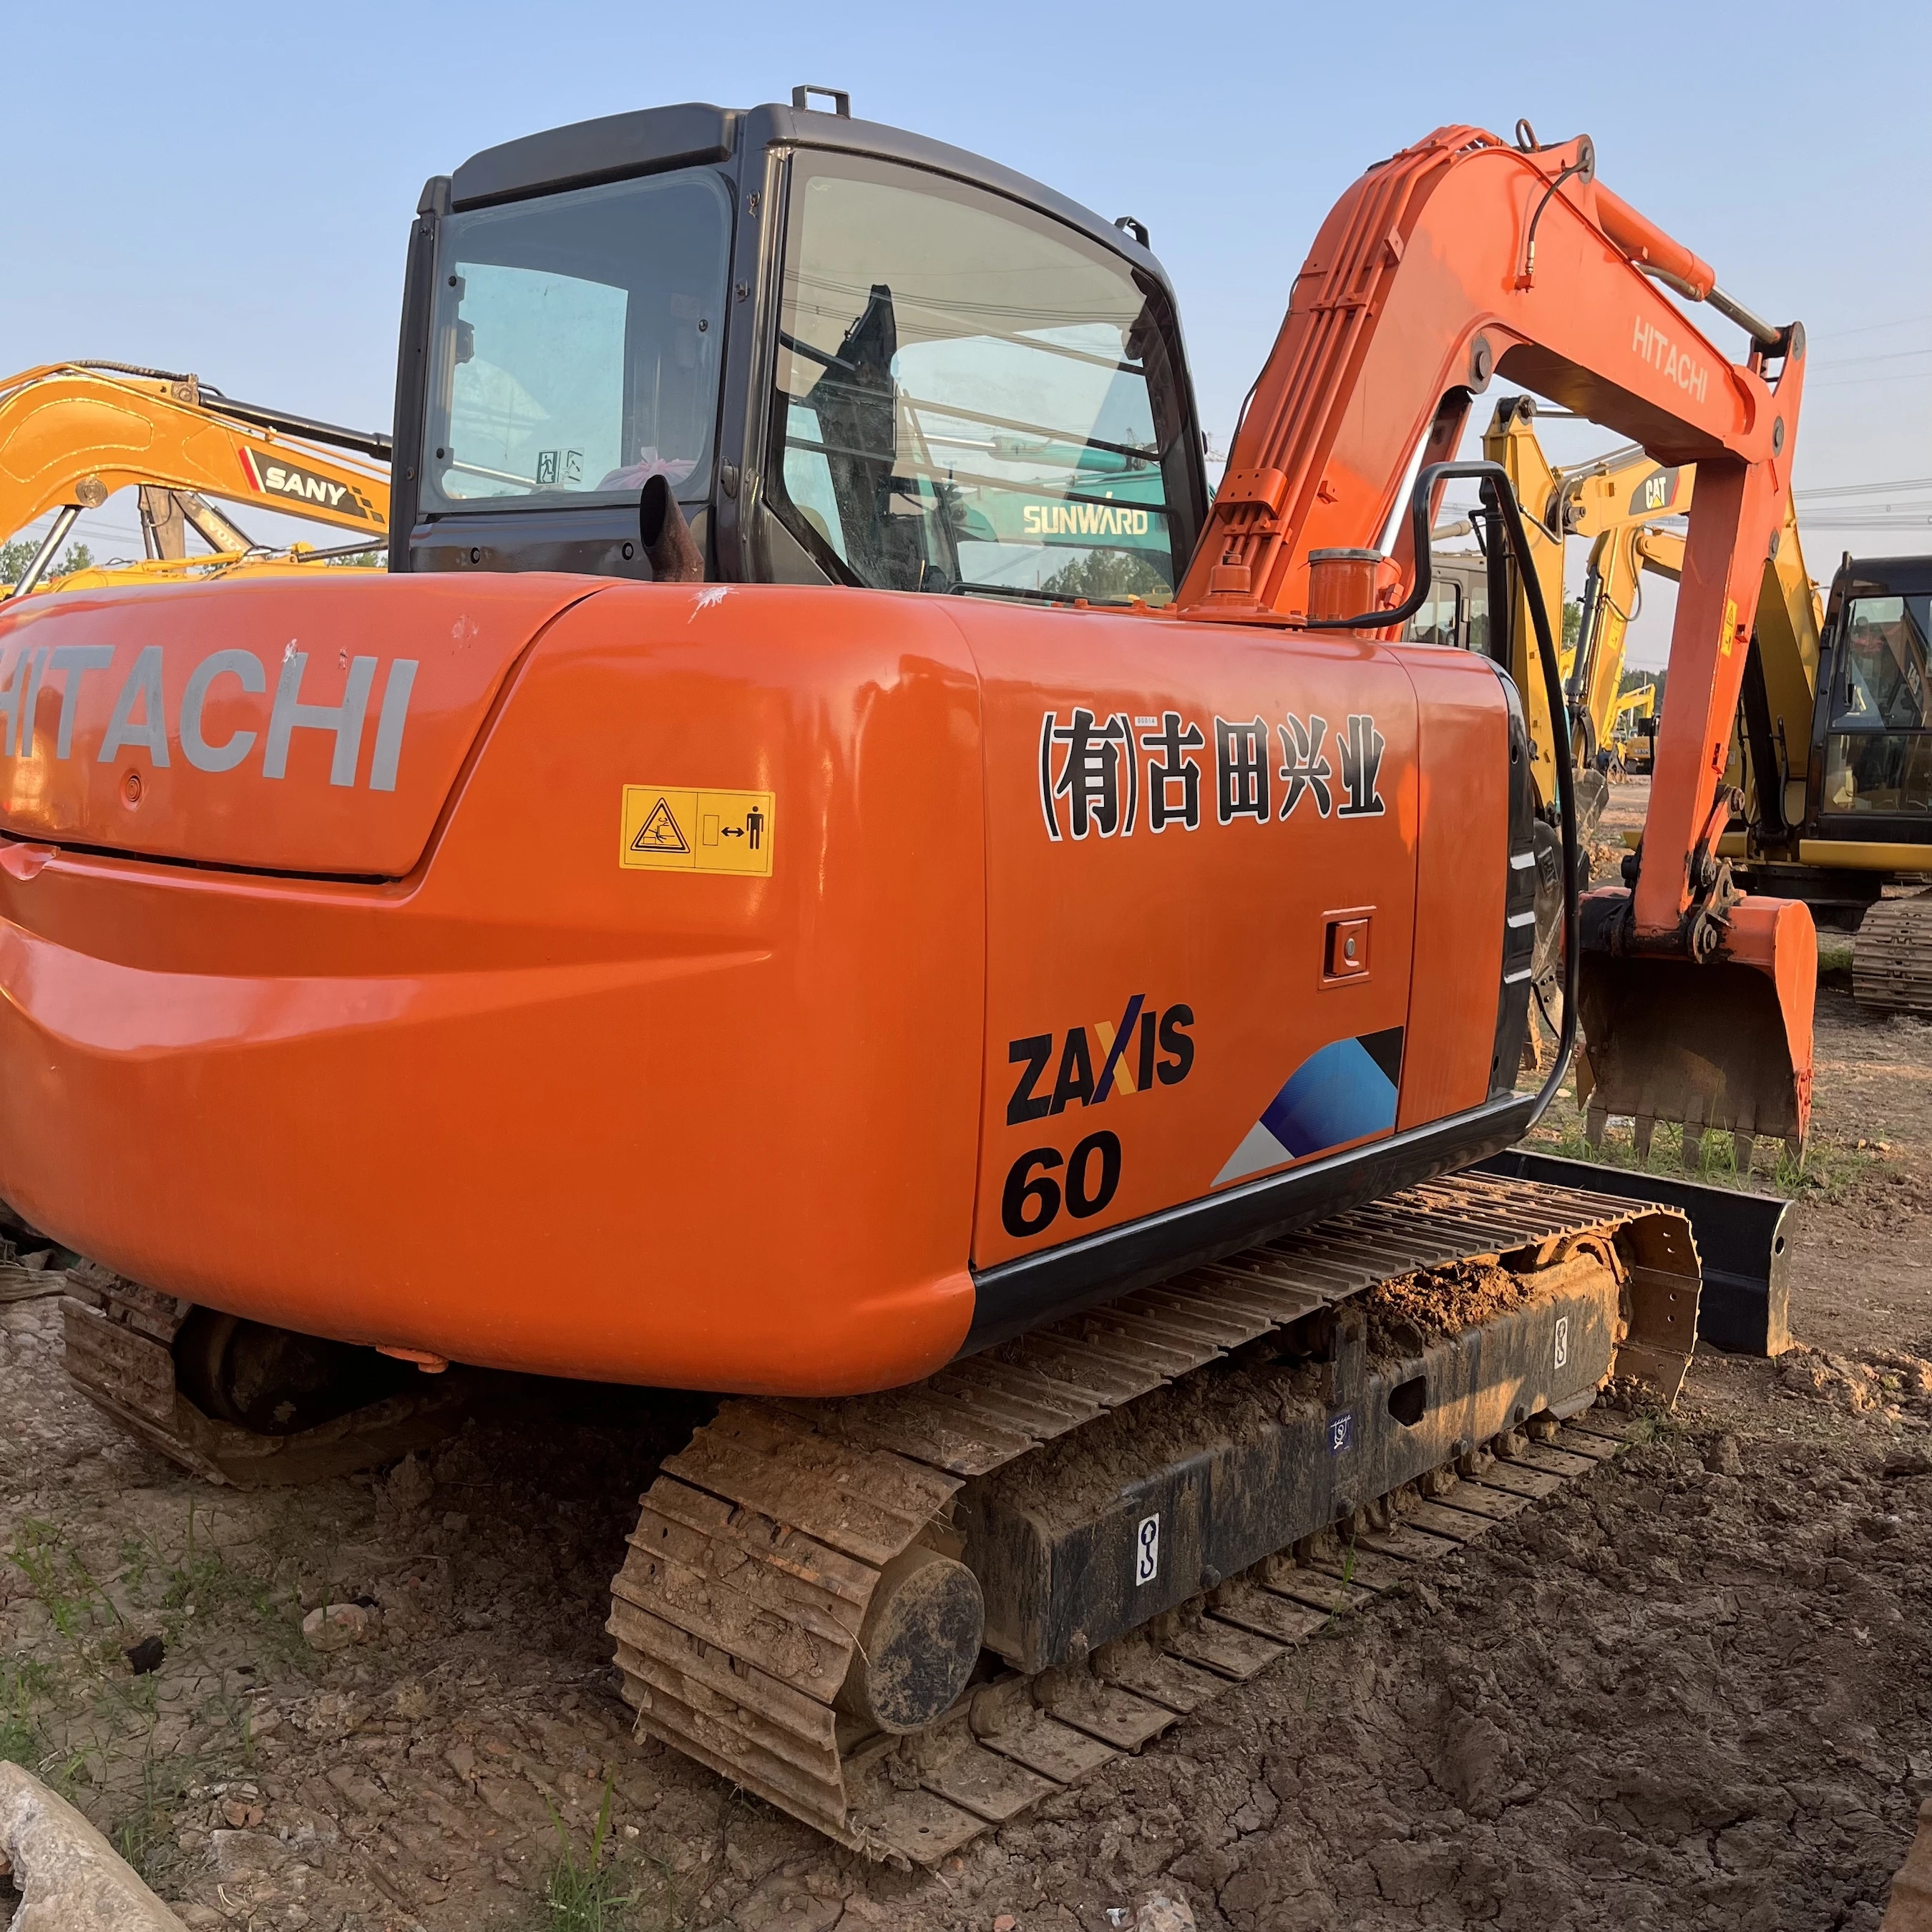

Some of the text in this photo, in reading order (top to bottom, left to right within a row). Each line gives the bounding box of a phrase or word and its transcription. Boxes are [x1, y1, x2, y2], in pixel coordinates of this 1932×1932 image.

[1632, 315, 1708, 404] HITACHI
[265, 467, 347, 506] SANY
[1023, 491, 1148, 535] SUNWARD
[1645, 477, 1666, 509] CAT
[0, 645, 419, 791] HITACHI
[1007, 994, 1194, 1126] ZAXIS
[1002, 1131, 1121, 1238] 60
